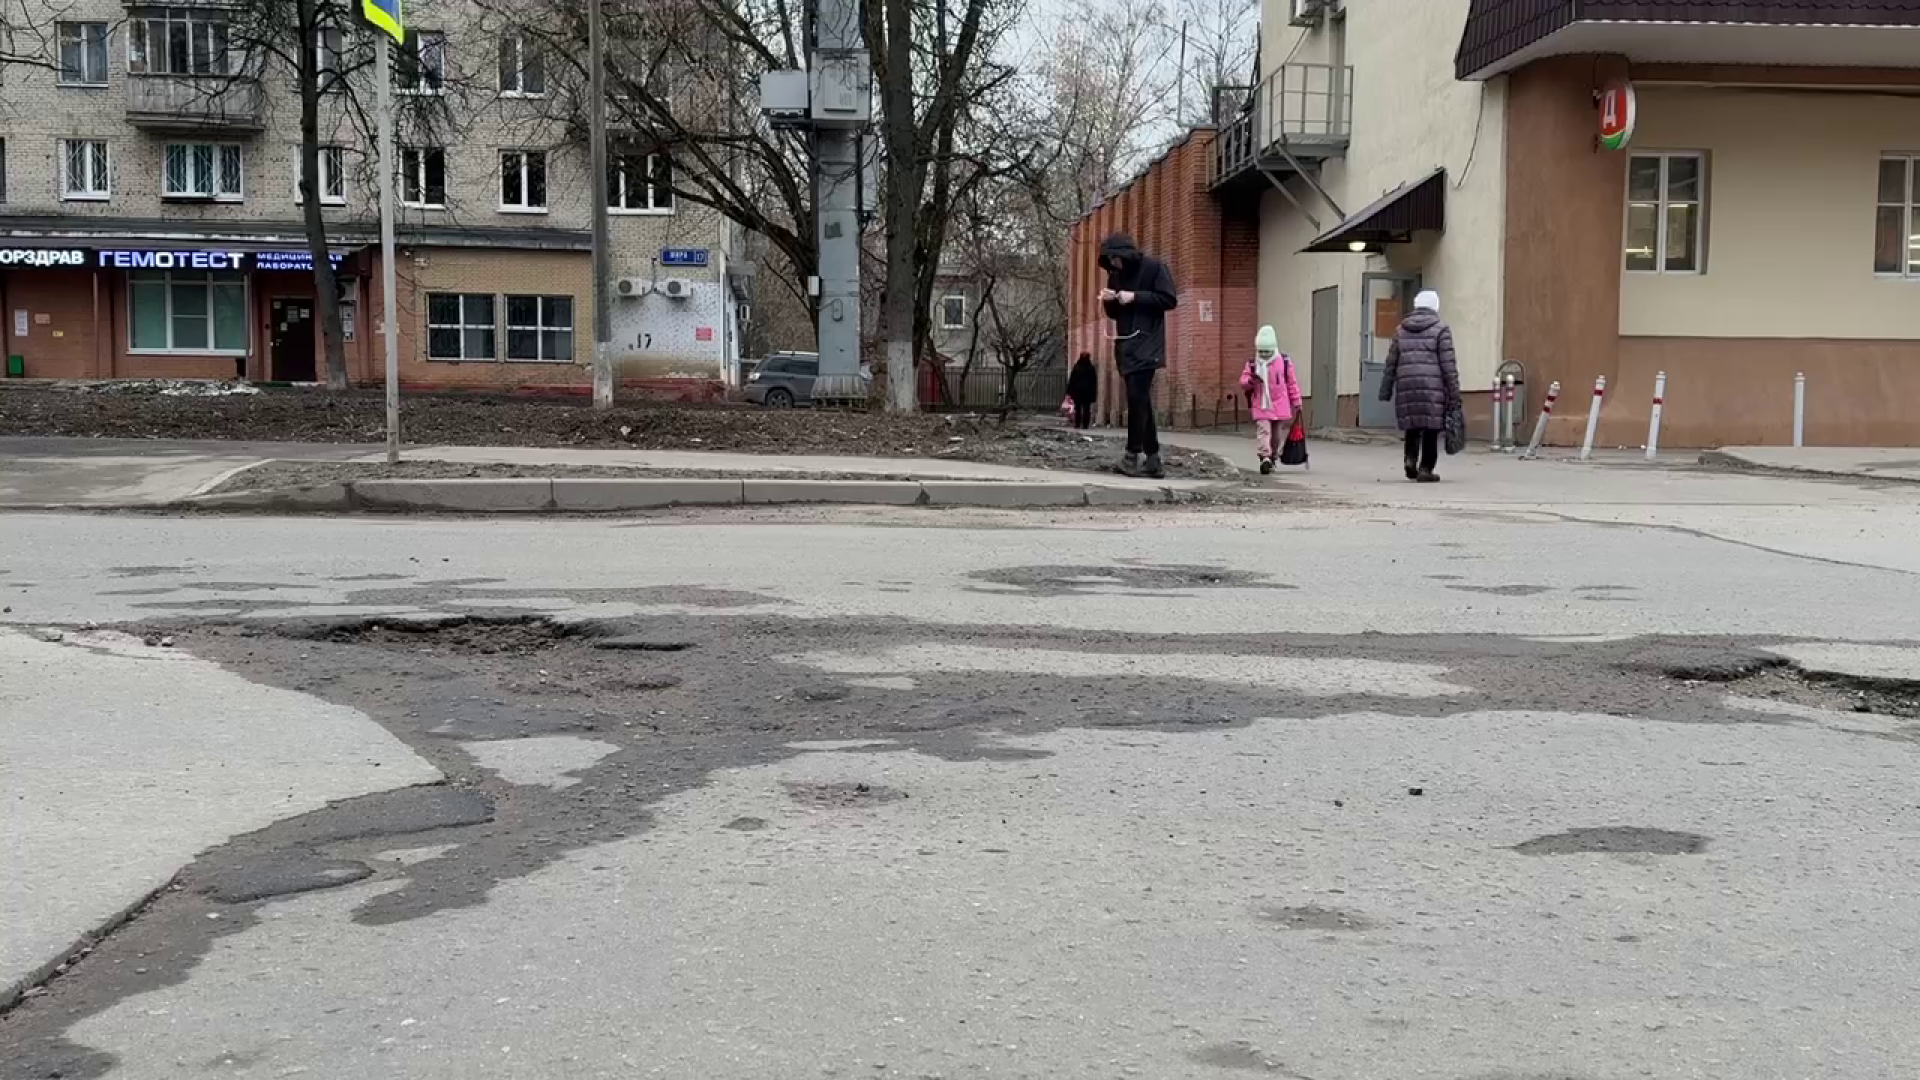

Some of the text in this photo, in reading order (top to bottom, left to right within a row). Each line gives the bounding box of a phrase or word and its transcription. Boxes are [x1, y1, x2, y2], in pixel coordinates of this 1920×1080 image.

[1603, 90, 1616, 129] Д
[0, 250, 85, 267] ОРЗДРАВ
[100, 251, 244, 269] ГЕМОТЕСТ
[256, 253, 343, 262] МЕДИЦИНАЯ
